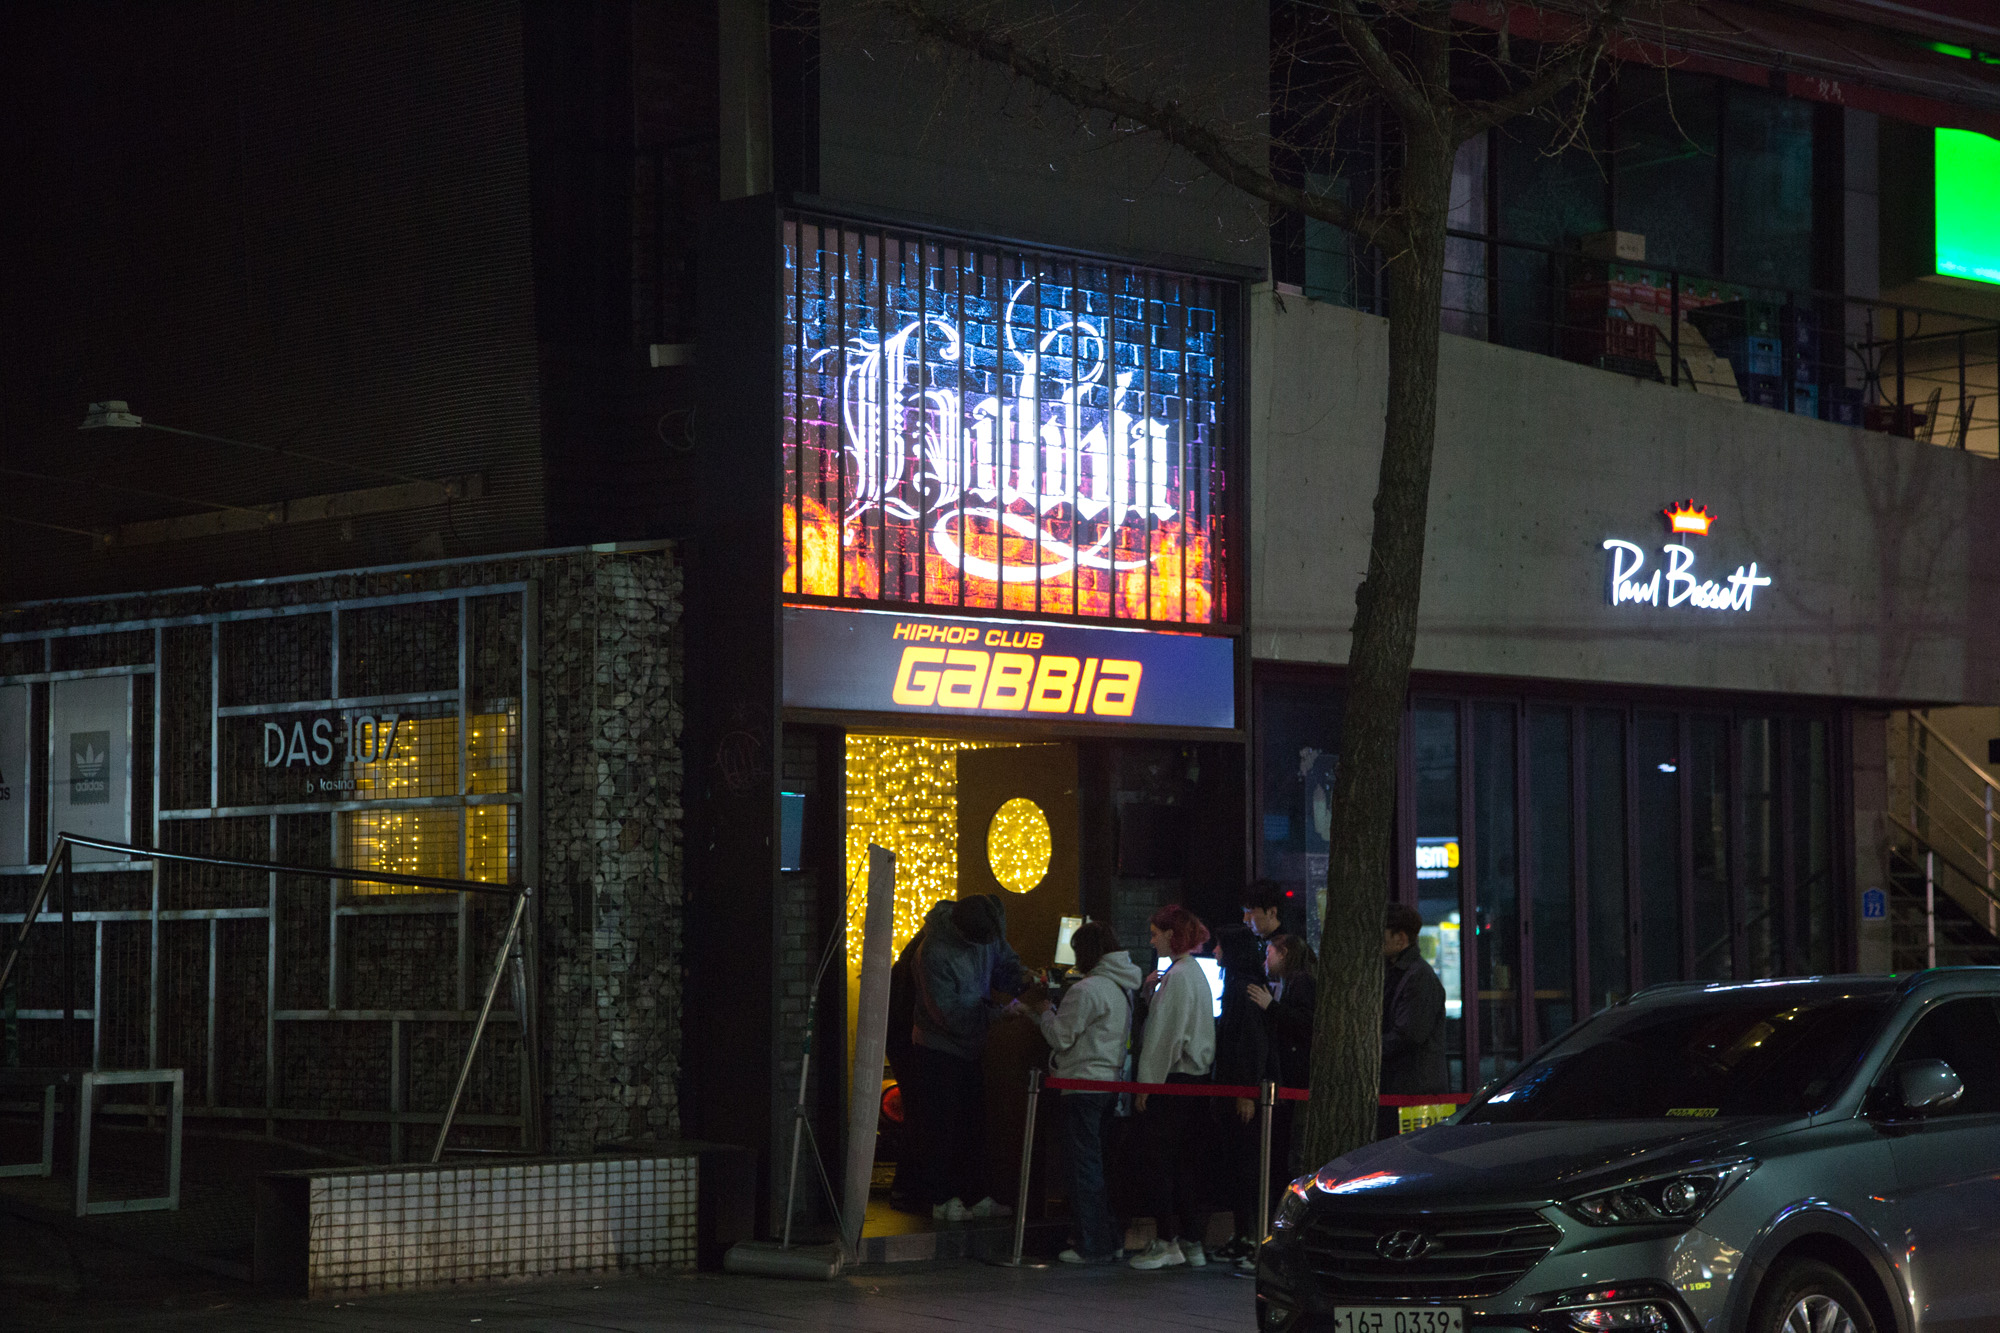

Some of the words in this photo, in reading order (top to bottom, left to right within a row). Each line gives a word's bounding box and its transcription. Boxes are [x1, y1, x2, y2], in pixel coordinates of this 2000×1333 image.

[1603, 539, 1661, 607] Paul
[1664, 544, 1772, 612] Bassett
[893, 622, 980, 644] HIPHOP
[984, 629, 1045, 649] CLUB
[75, 779, 105, 792] adidas
[319, 778, 355, 792] kasina
[1395, 1311, 1450, 1333] 0339
